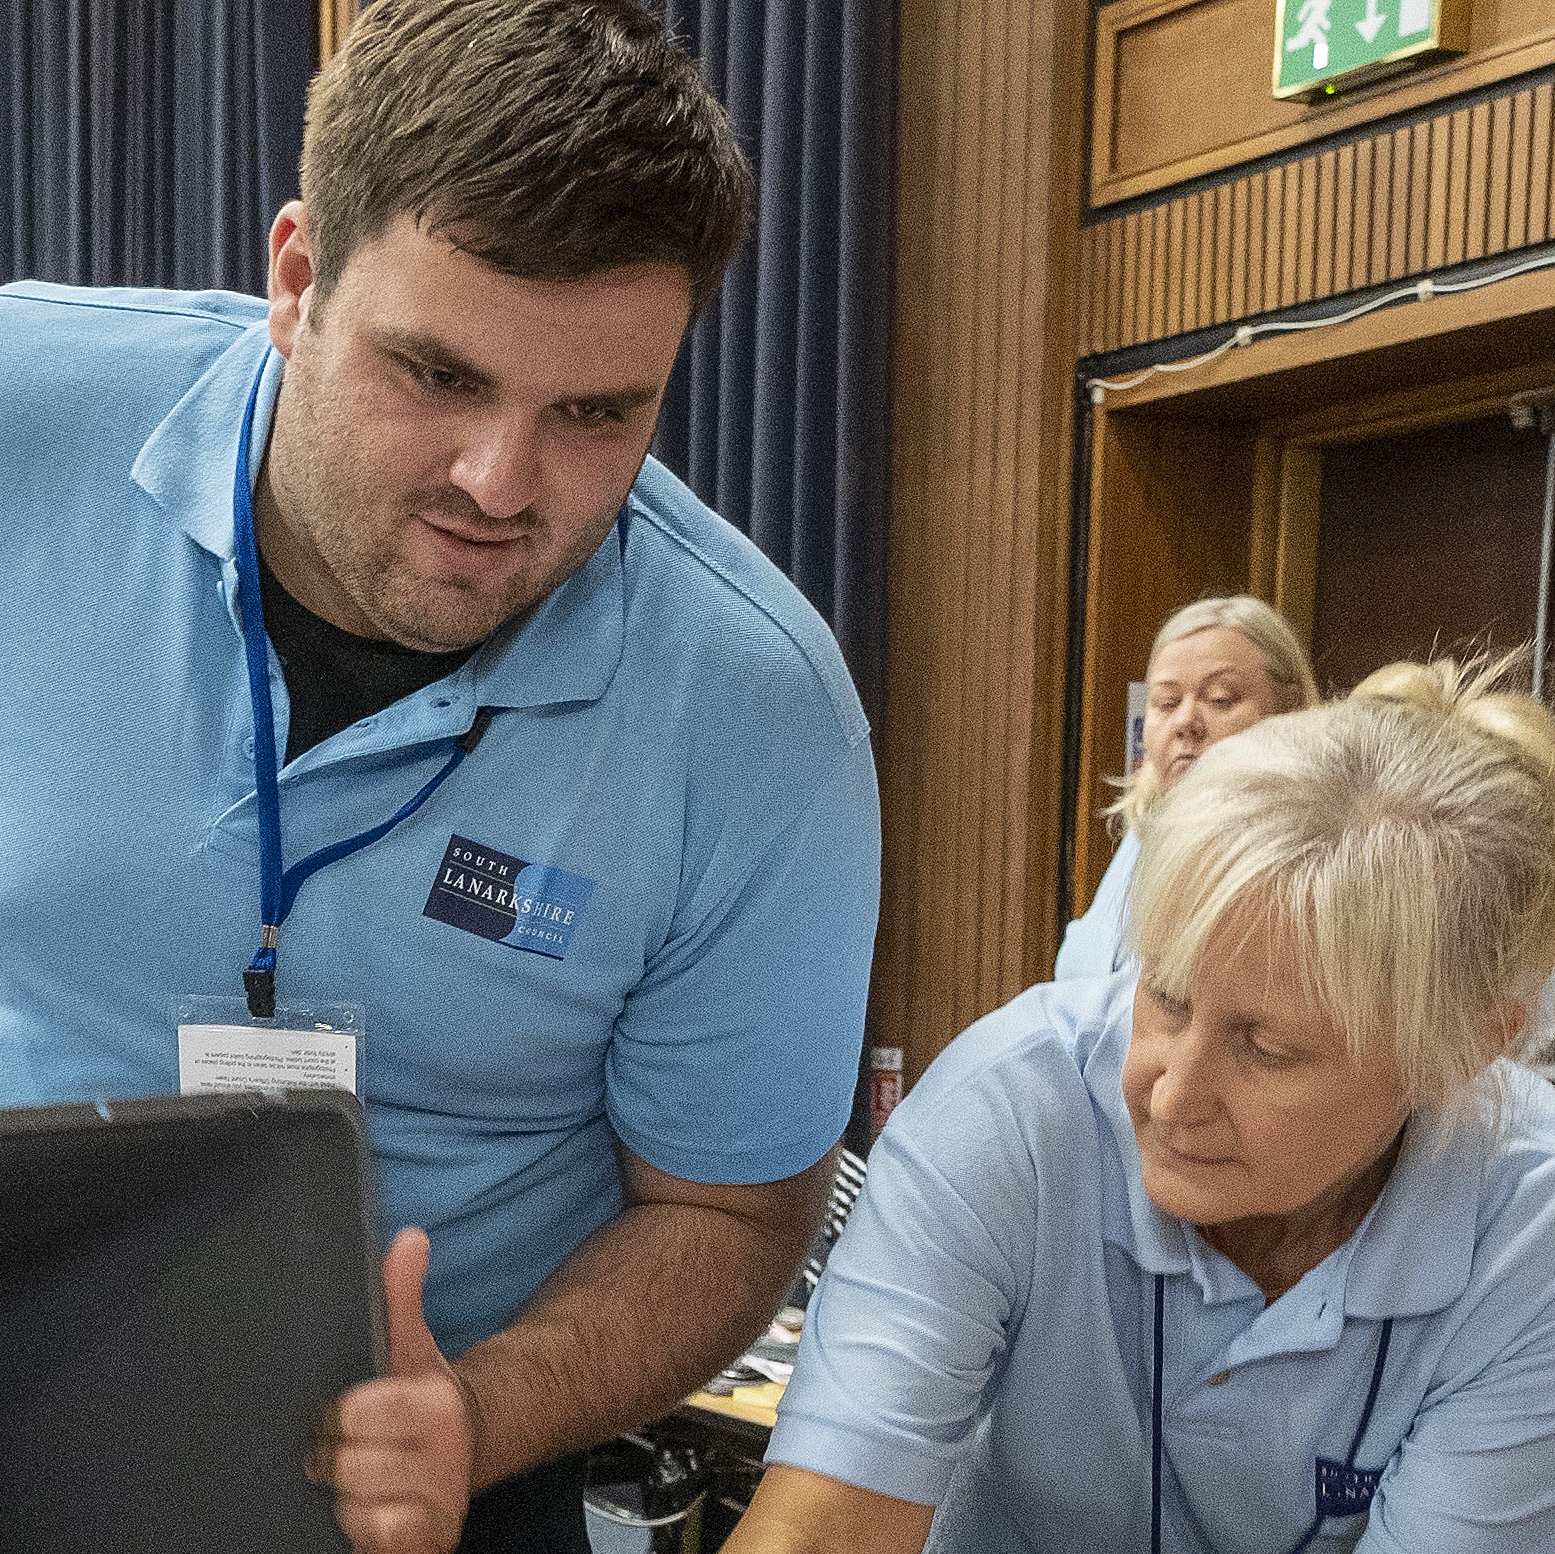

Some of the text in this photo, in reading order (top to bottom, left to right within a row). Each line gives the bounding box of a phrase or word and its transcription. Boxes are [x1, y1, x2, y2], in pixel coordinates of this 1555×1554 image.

[452, 847, 509, 876] SOUTH
[443, 868, 575, 925] LANARKSHIRE
[517, 925, 564, 944] COUNCIL
